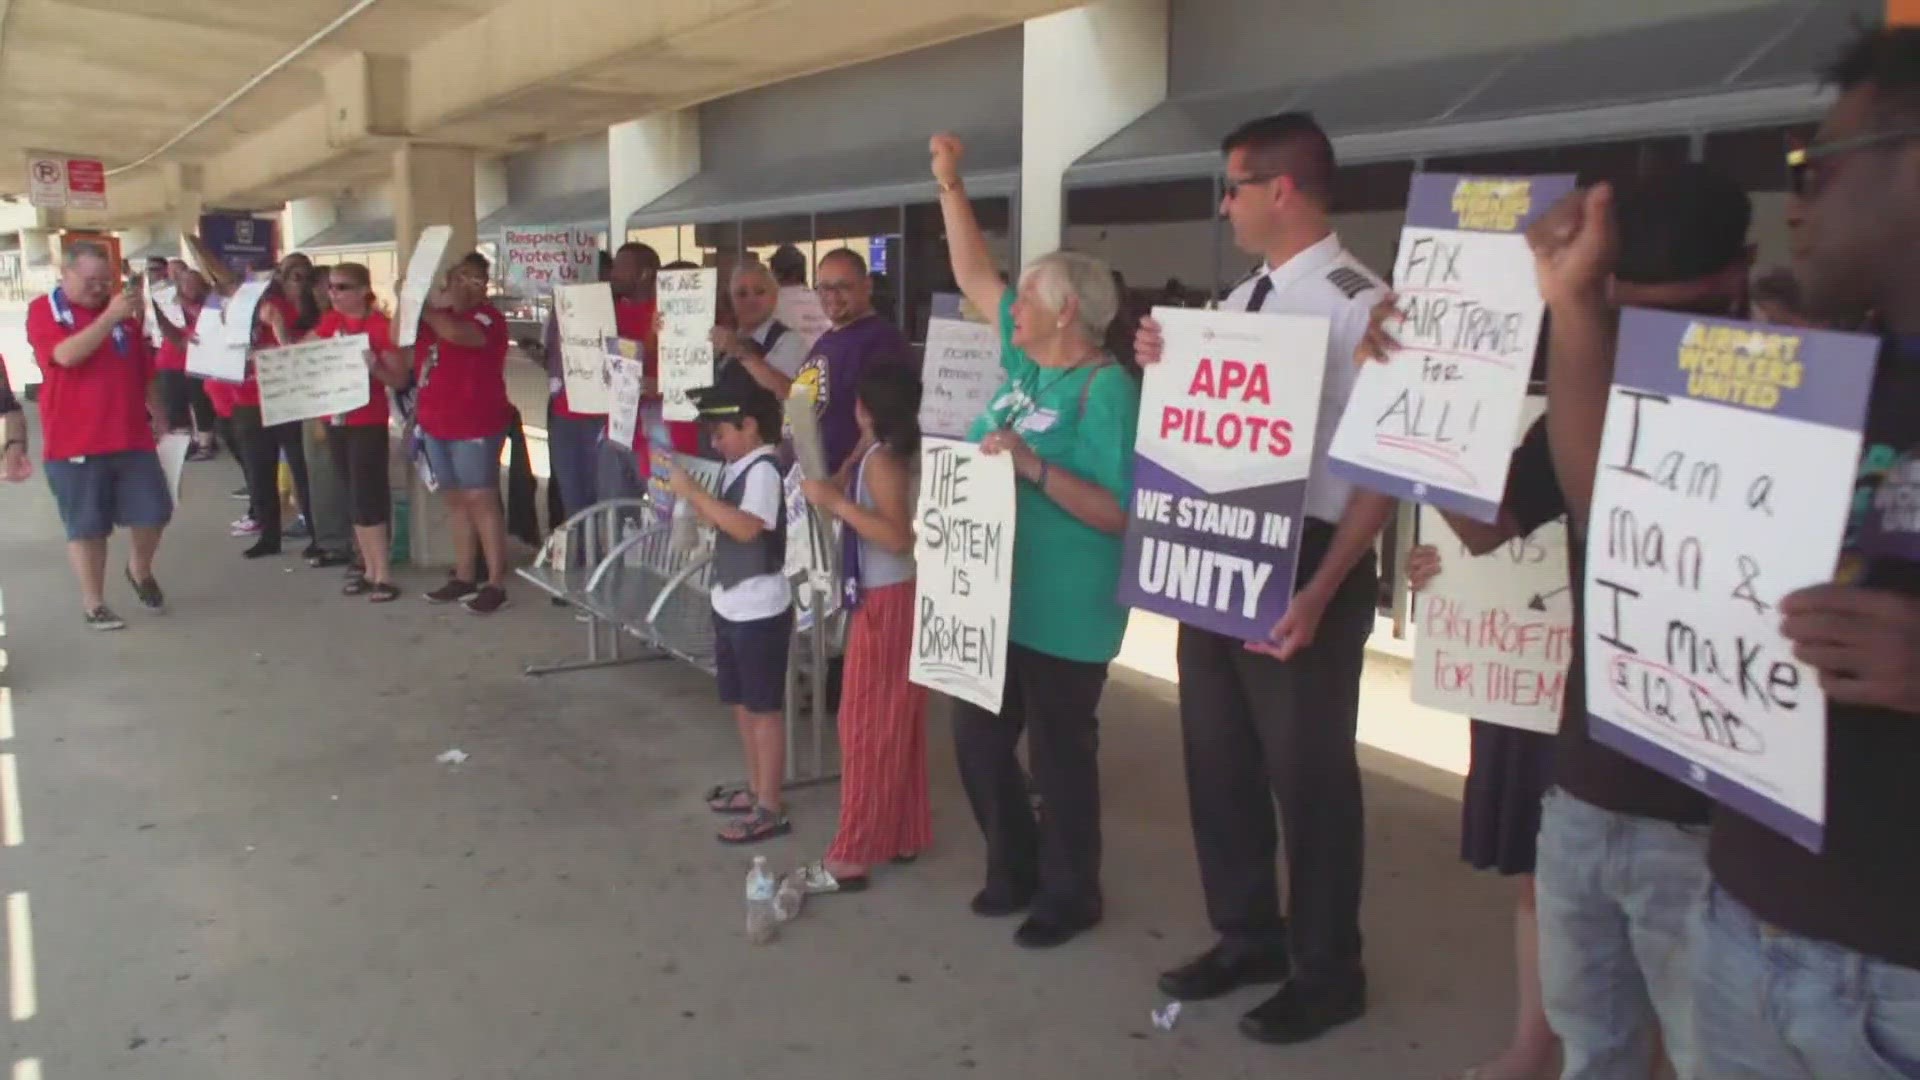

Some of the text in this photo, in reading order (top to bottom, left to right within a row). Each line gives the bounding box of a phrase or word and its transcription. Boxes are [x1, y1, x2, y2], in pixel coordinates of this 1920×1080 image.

[506, 230, 598, 247] Respect Us
[509, 249, 568, 264] Protect
[1404, 237, 1462, 283] FIX
[526, 266, 554, 281] Pay
[1399, 296, 1524, 355] AIR TRAVEL
[1188, 357, 1272, 405] APA
[1678, 344, 1804, 389] WORKERS
[1688, 373, 1779, 409] UNITED
[1160, 406, 1294, 457] PILOTS
[1376, 388, 1480, 452] ALL!
[927, 445, 972, 508] THE
[1606, 390, 1776, 517] I am a
[923, 507, 1002, 583] SYSTEM
[1136, 488, 1291, 549] WE STAND IN
[951, 565, 972, 597] IS
[1138, 536, 1273, 619] UNITY
[1731, 555, 1772, 615] &
[918, 595, 997, 680] BROKEN
[1595, 578, 1642, 655] I
